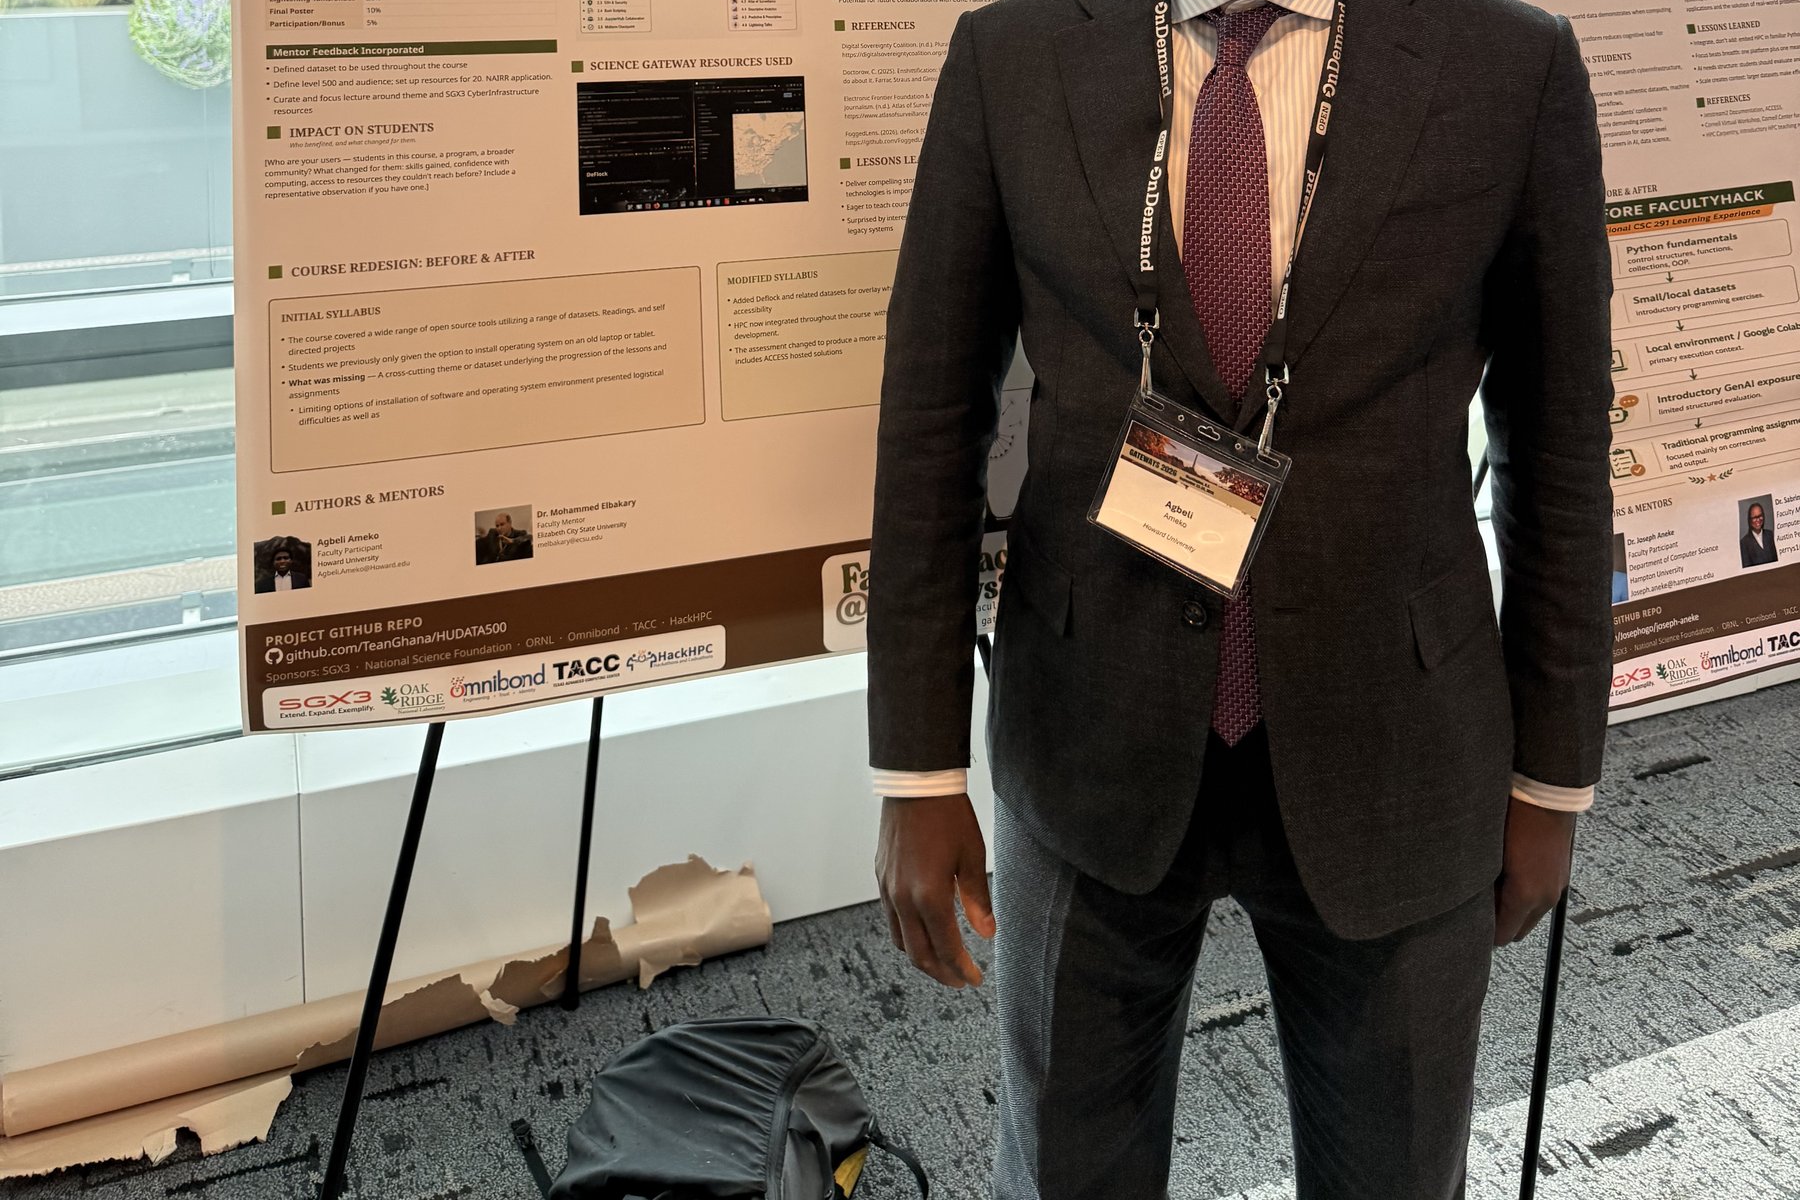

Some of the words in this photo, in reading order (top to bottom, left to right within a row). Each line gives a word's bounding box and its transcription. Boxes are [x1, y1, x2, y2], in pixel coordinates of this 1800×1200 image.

[851, 21, 915, 30] REFERENCES
[1696, 22, 1727, 33] LESSONS
[1728, 20, 1760, 30] LEARNED
[273, 48, 310, 56] Mentor
[312, 47, 359, 56] Feedback
[361, 45, 424, 55] Incorporated
[1155, 2, 1172, 97] OnDemand
[273, 65, 304, 73] Defined
[381, 62, 426, 71] throughout
[590, 60, 639, 70] SCIENCE
[642, 58, 696, 69] GATEWAY
[699, 57, 762, 67] RESOURCES
[765, 56, 792, 66] USED
[1706, 93, 1750, 105] REFERENCES
[1319, 106, 1329, 130] OPEN
[289, 126, 341, 137] IMPACT
[344, 125, 363, 135] ON
[367, 122, 434, 134] STUDENTS
[1156, 134, 1165, 157] OPEN
[856, 156, 901, 166] LESSONS
[1648, 189, 1764, 213] FACULTYHACK
[1140, 167, 1162, 272] OnDemand
[1626, 243, 1664, 255] Python
[1666, 233, 1738, 249] fundamentals
[291, 263, 346, 277] COURSE
[350, 258, 422, 273] REDESIGN:
[426, 253, 477, 267] BEFORE
[480, 253, 490, 263] &
[493, 249, 535, 262] AFTER
[1632, 290, 1691, 304] Small/local
[1693, 284, 1736, 295] datasets
[281, 311, 324, 322] INITIAL
[326, 306, 380, 319] SYLLABUS
[1161, 464, 1178, 477] 2026
[294, 494, 361, 512] AUTHORS
[364, 493, 375, 504] &
[378, 485, 444, 502] MENTORS
[1165, 500, 1194, 519] Agbeli
[1163, 512, 1187, 528] Ameko
[316, 535, 345, 547] Agbeli
[347, 532, 379, 542] Ameko
[1143, 522, 1167, 538] Howard
[1167, 534, 1196, 553] University
[265, 629, 325, 646] PROJECT
[329, 622, 382, 638] GITHUB
[387, 616, 422, 631] REPO
[265, 669, 319, 683] Sponsors:
[322, 663, 350, 675] SGX3
[364, 655, 409, 670] National
[412, 651, 451, 664] Science
[453, 642, 512, 658] Foundation
[525, 635, 555, 648] ORNL
[567, 626, 620, 641] Omnibond
[632, 618, 656, 631] TACC
[669, 610, 712, 626] HackHPC
[286, 621, 507, 664] github.com/TeanGhana/HUDATA500
[658, 644, 713, 661] HackHPC
[553, 654, 620, 680] TACC
[400, 683, 429, 695] OAK
[450, 663, 545, 698] Omnibond
[279, 690, 372, 710] SGX3
[401, 694, 444, 707] RIDGE
